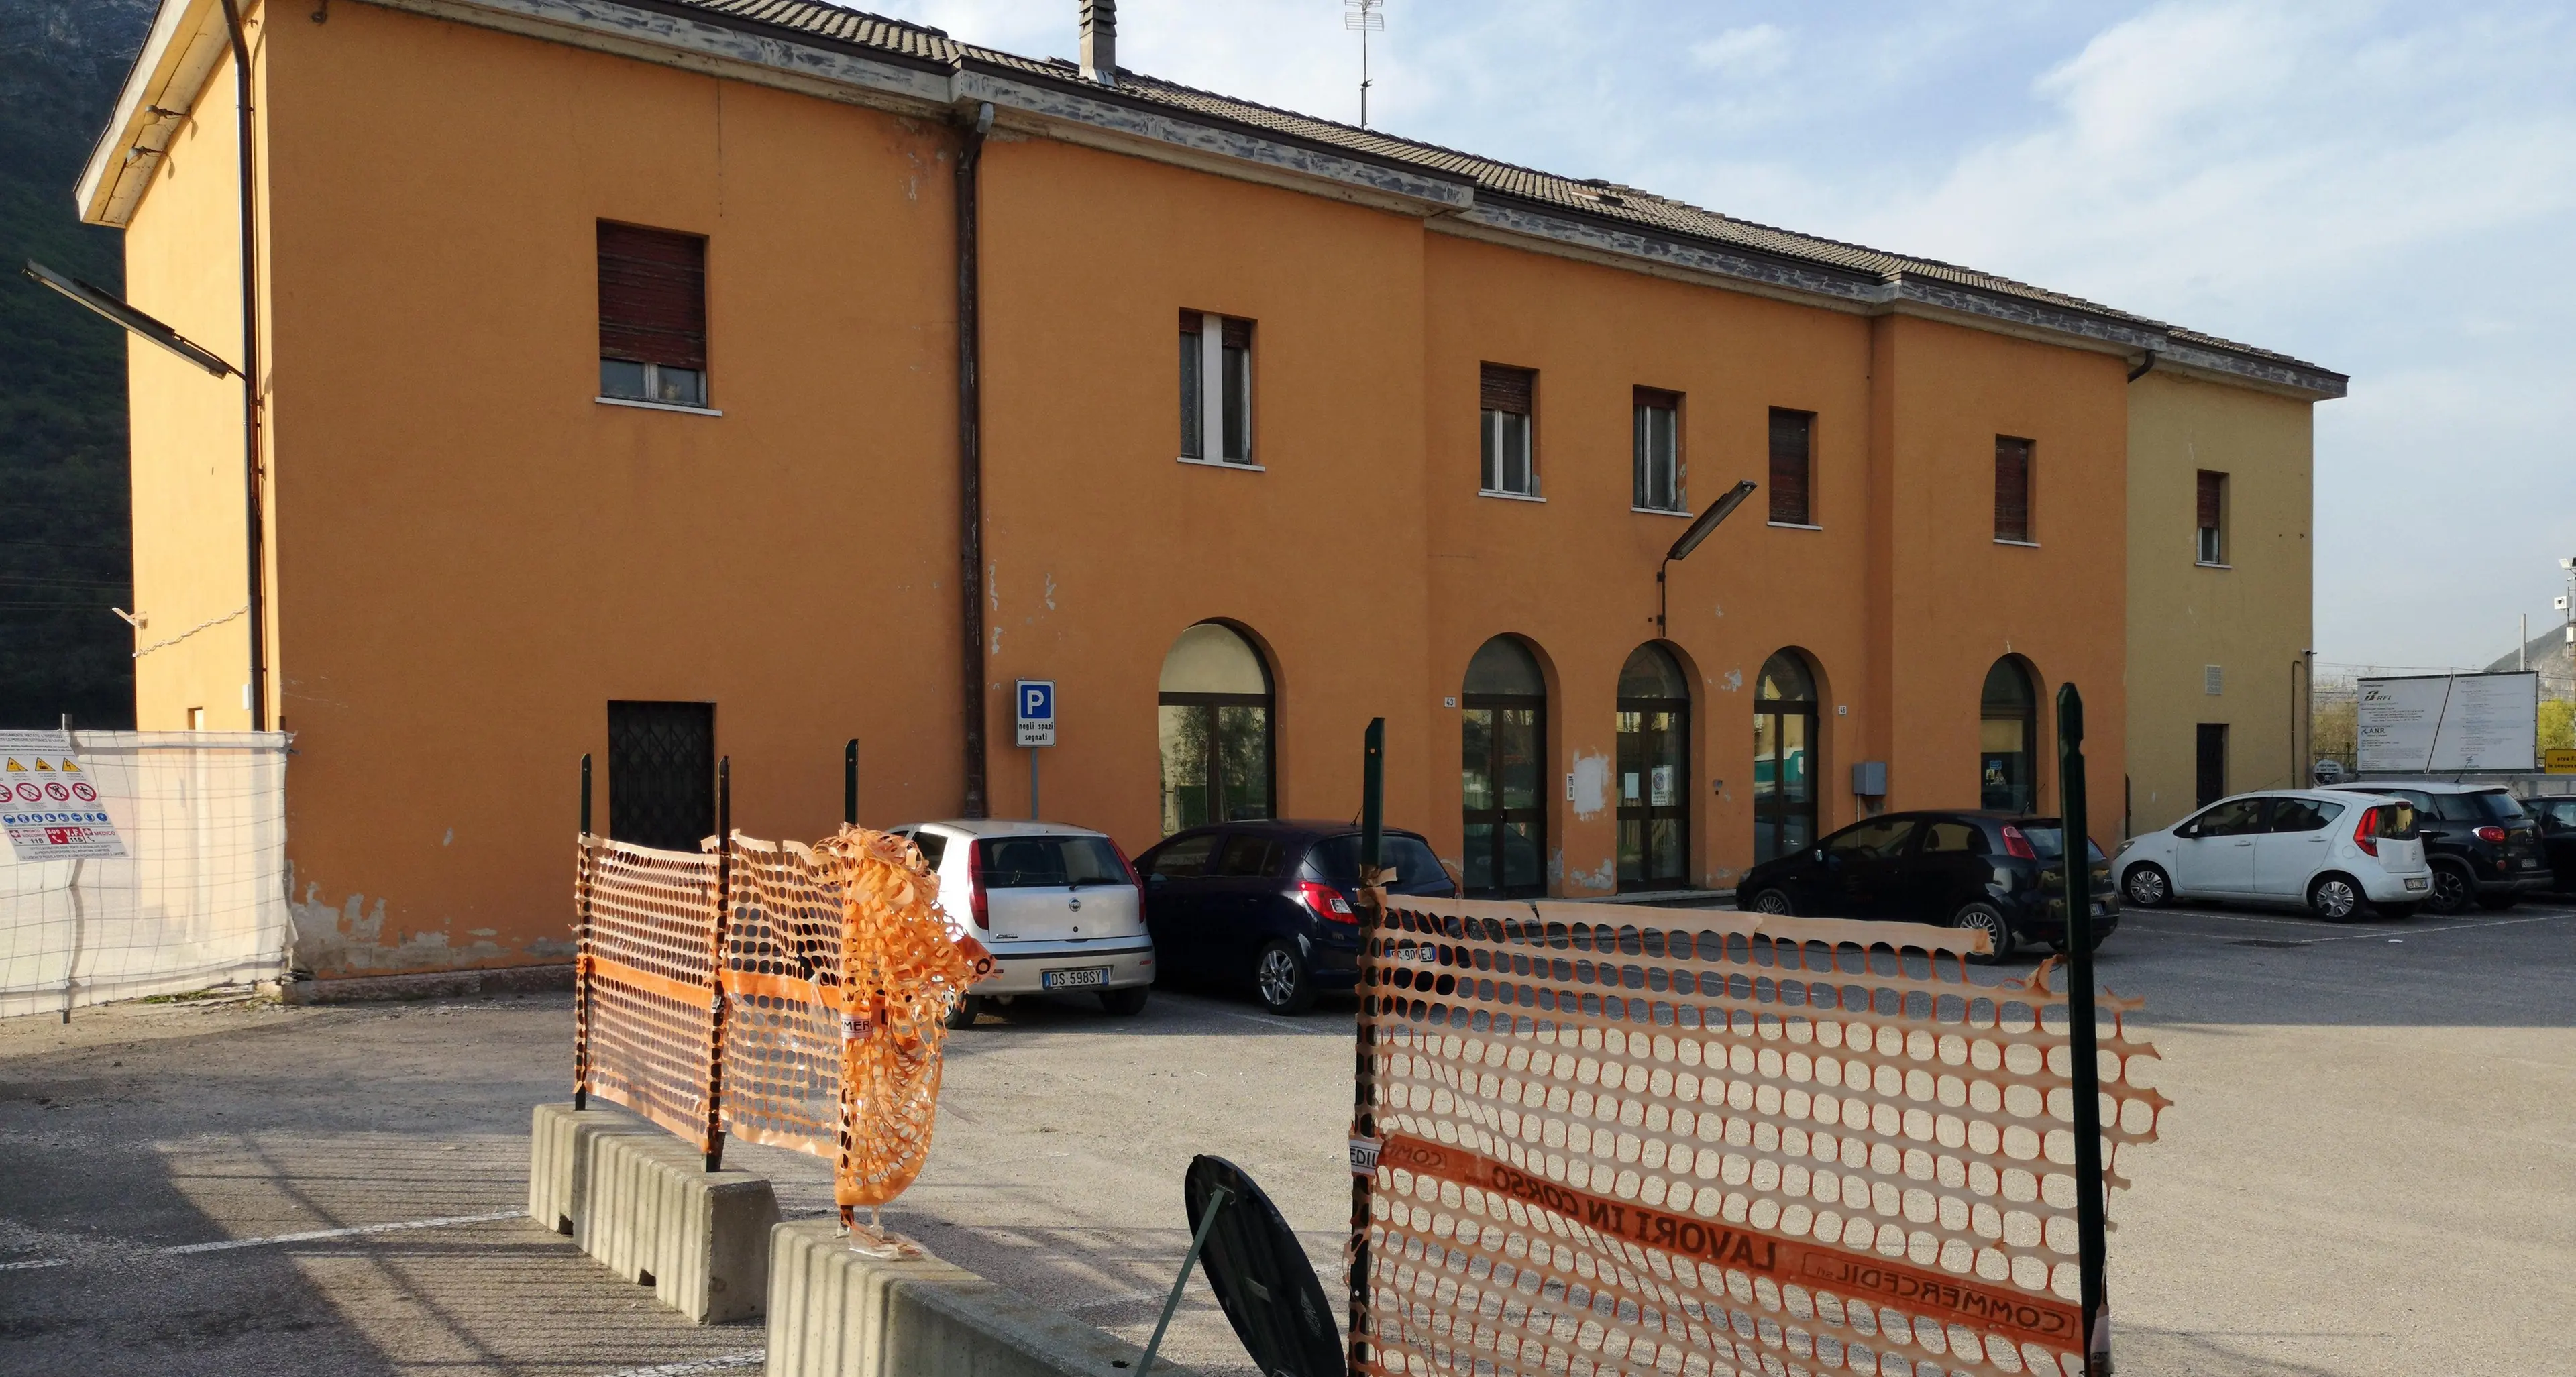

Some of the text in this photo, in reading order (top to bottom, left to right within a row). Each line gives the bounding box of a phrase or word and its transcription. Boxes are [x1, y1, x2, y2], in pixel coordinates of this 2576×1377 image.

[1027, 690, 1044, 715] P
[1019, 722, 1053, 731] negli spazi
[1025, 732, 1048, 742] segnati
[1051, 971, 1101, 985] DS 598SY
